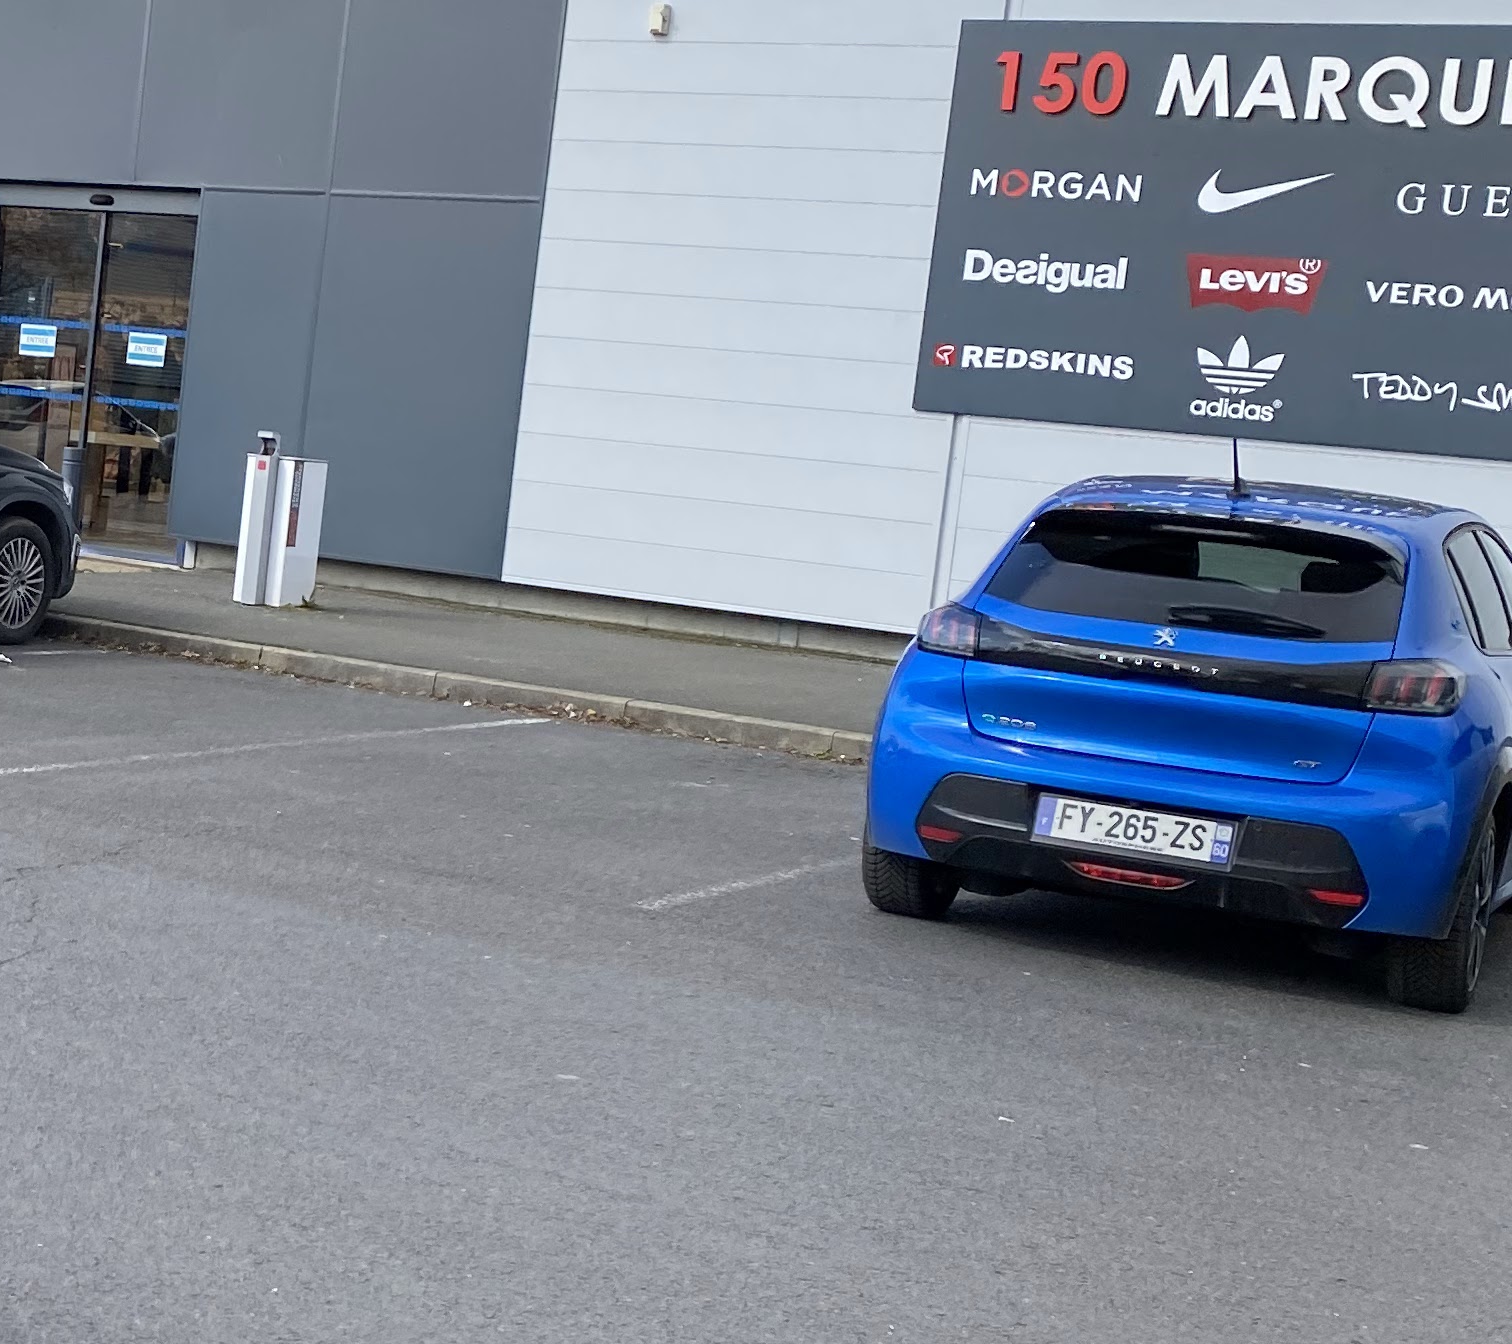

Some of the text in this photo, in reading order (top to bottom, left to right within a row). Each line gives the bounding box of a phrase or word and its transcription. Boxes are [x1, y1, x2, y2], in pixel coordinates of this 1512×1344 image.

[995, 51, 1512, 129] 150 MARQU
[970, 168, 1143, 203] MORGAN
[962, 248, 1129, 294] Desigual
[1365, 280, 1512, 312] VERO M
[961, 344, 1135, 381] REDSKINS
[1189, 397, 1275, 422] adidas
[1351, 372, 1458, 412] TEDDY
